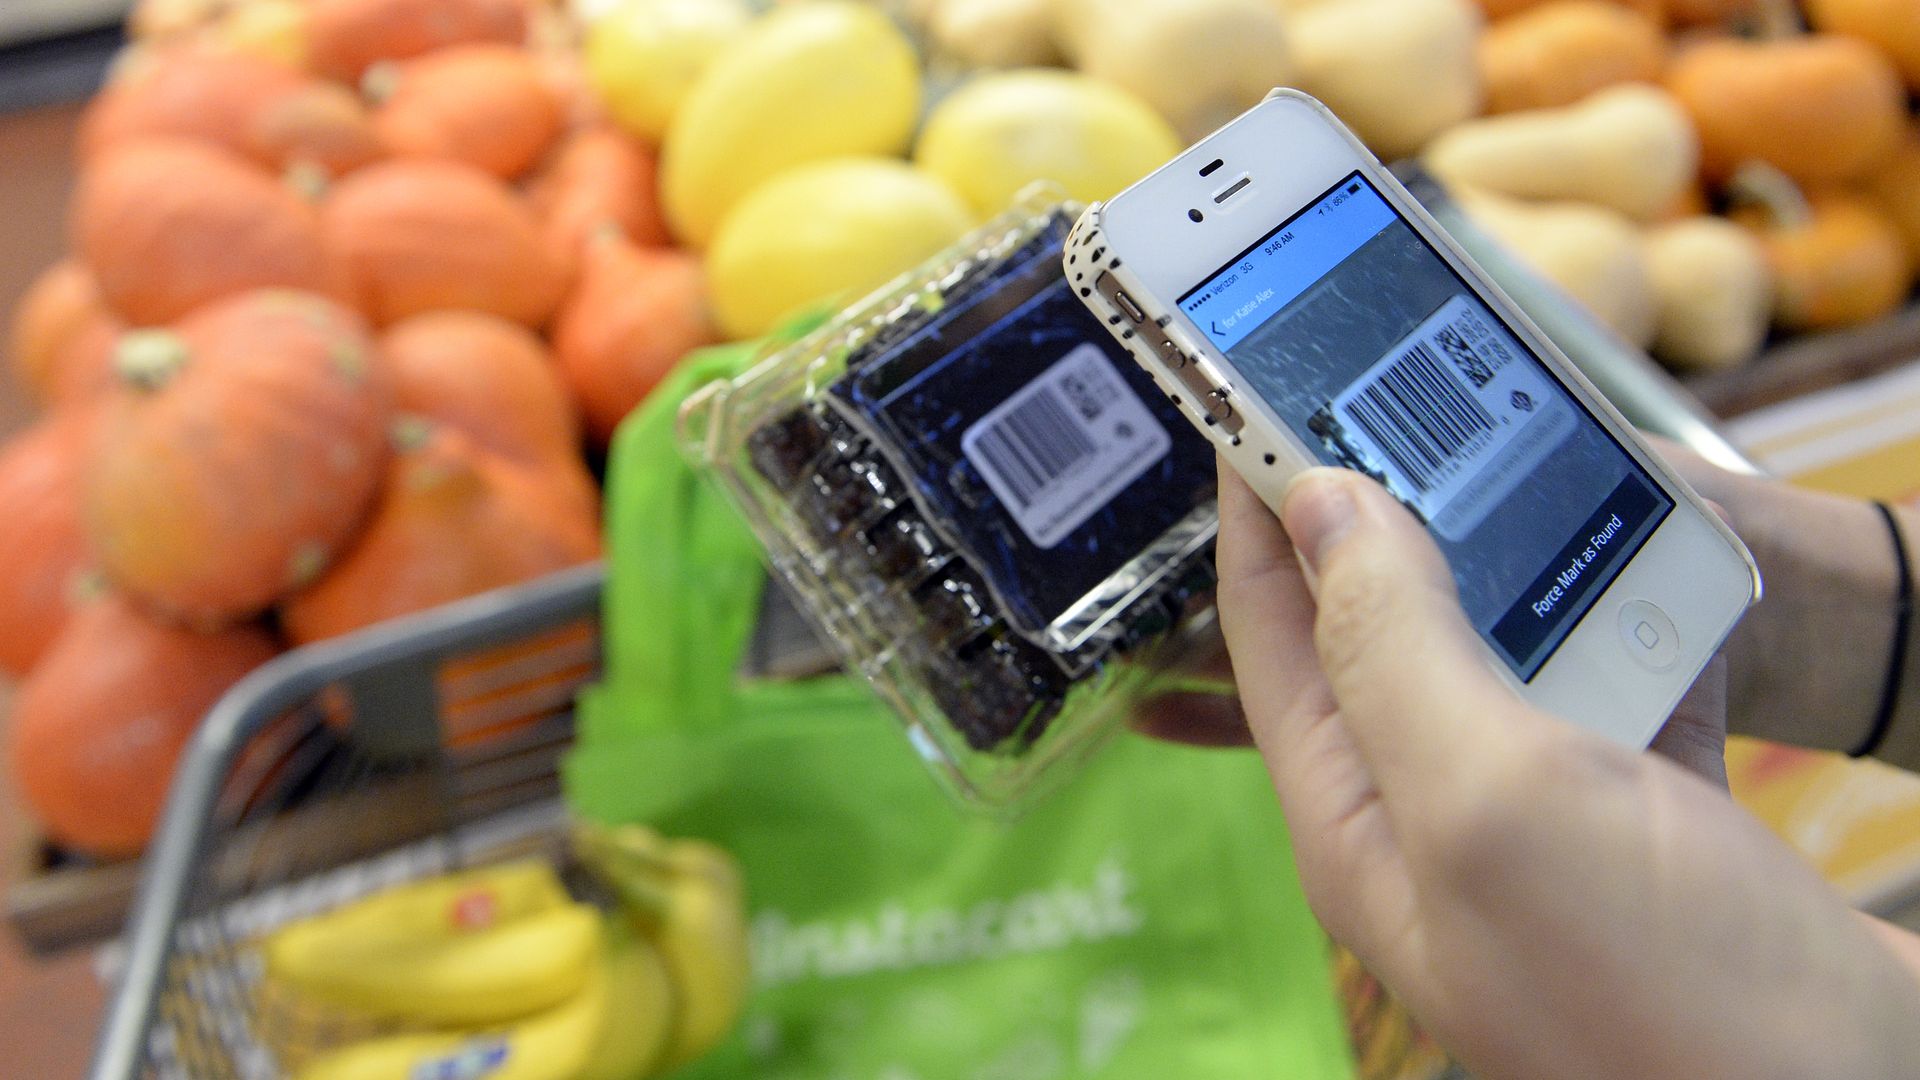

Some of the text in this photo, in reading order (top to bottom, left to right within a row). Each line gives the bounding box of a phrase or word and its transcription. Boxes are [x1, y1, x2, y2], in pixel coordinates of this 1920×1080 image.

[1332, 192, 1349, 206] 86%
[1264, 231, 1295, 256] 9:46 AM
[1210, 262, 1254, 295] Verizon 3G
[1222, 287, 1275, 329] for Katie Alex
[1531, 513, 1623, 618] Force Mark as Found
